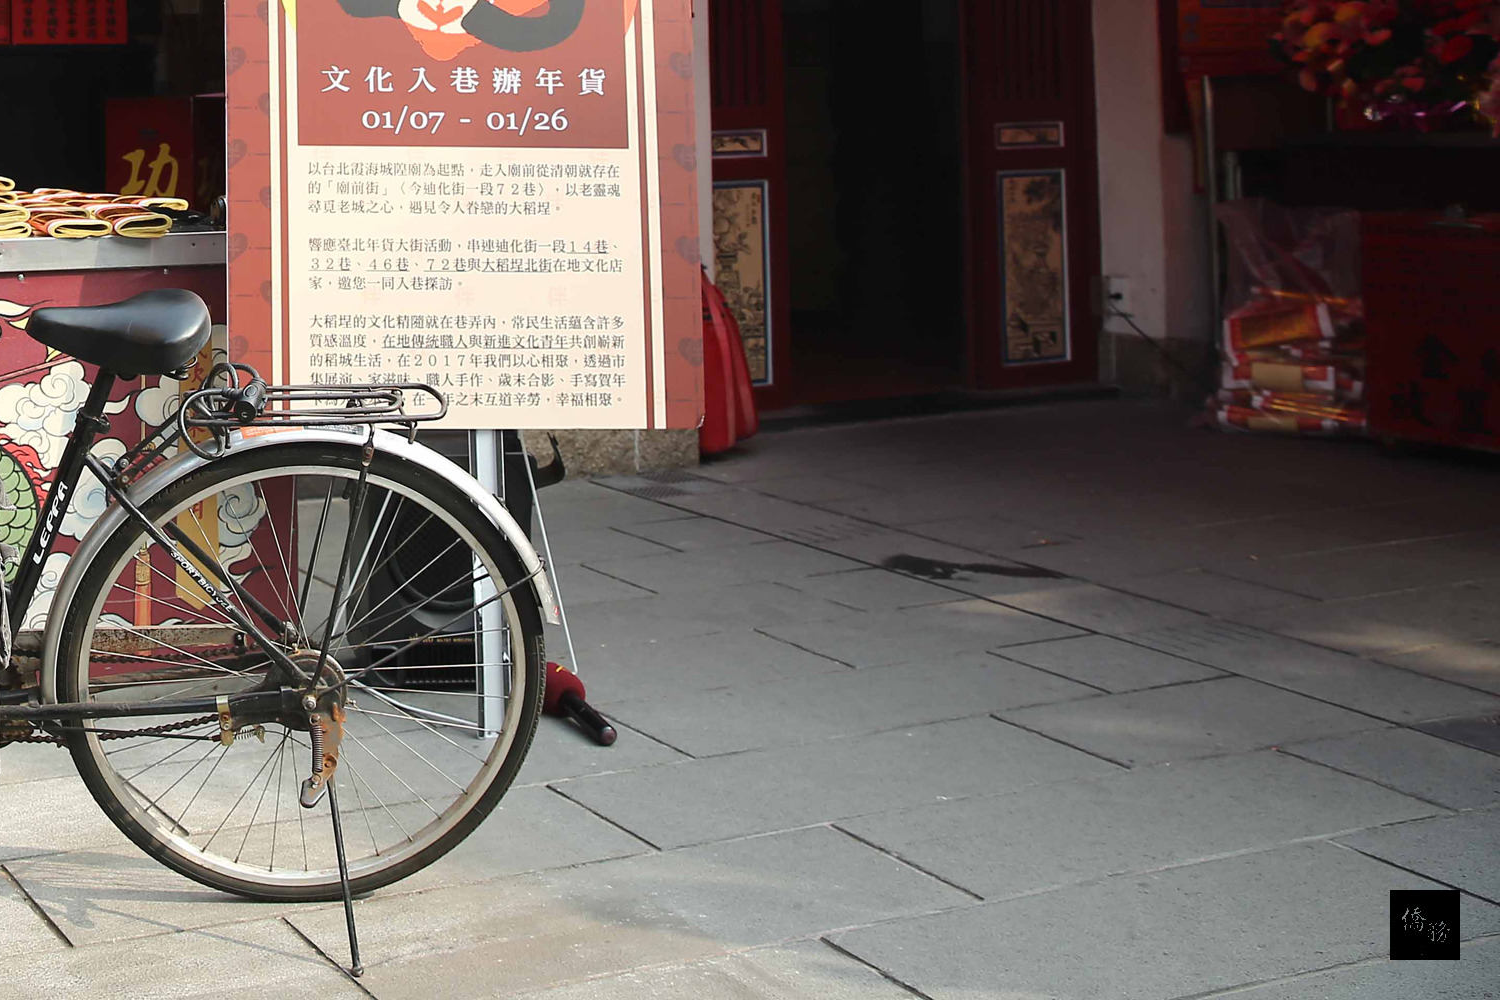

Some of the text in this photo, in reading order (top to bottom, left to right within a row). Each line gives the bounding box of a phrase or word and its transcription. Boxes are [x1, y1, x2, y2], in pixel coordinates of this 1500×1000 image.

[321, 65, 606, 95] 文化入巷辦年貨
[361, 108, 445, 135] 01/07
[486, 107, 568, 135] 01/26
[33, 481, 68, 565] LEPPA
[170, 549, 200, 578] SPORT
